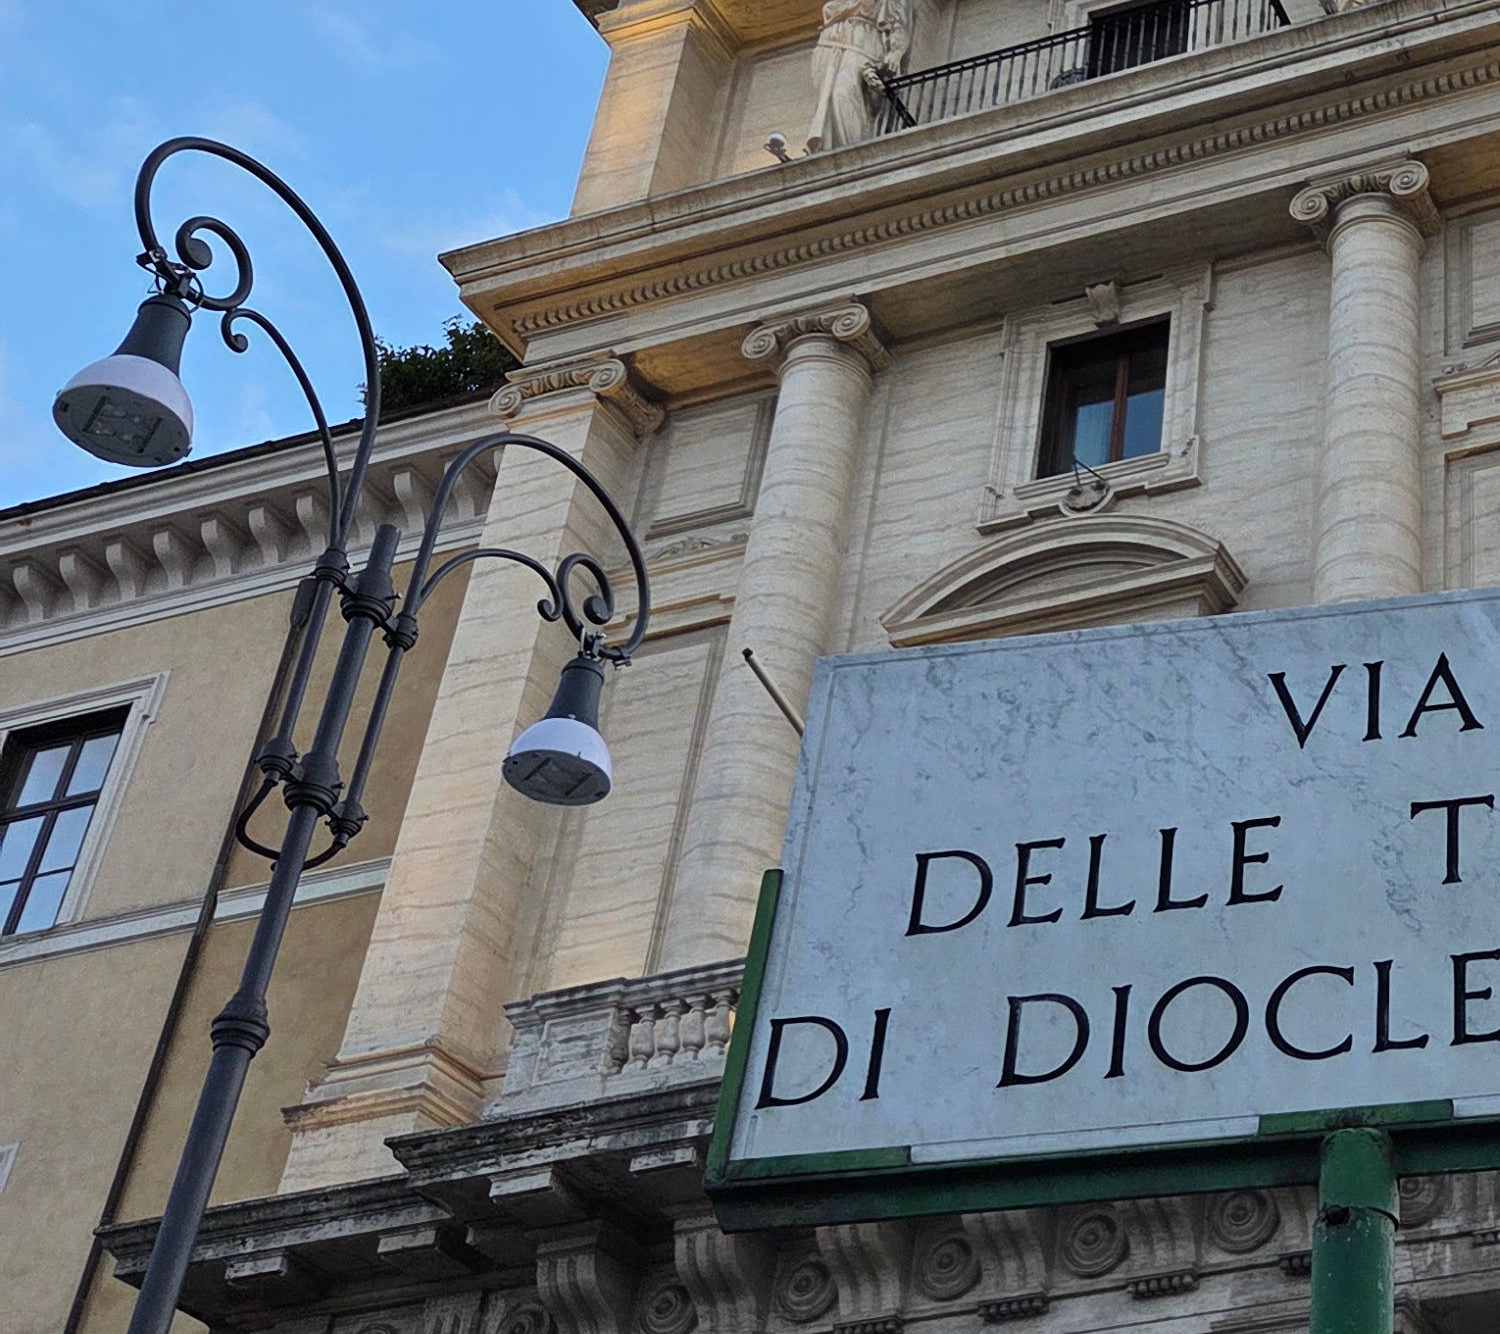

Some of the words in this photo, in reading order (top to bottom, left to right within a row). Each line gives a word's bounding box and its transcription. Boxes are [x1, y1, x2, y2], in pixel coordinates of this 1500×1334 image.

[1267, 651, 1485, 750] VIA
[904, 815, 1284, 937] DELLE
[753, 1007, 892, 1111] DI
